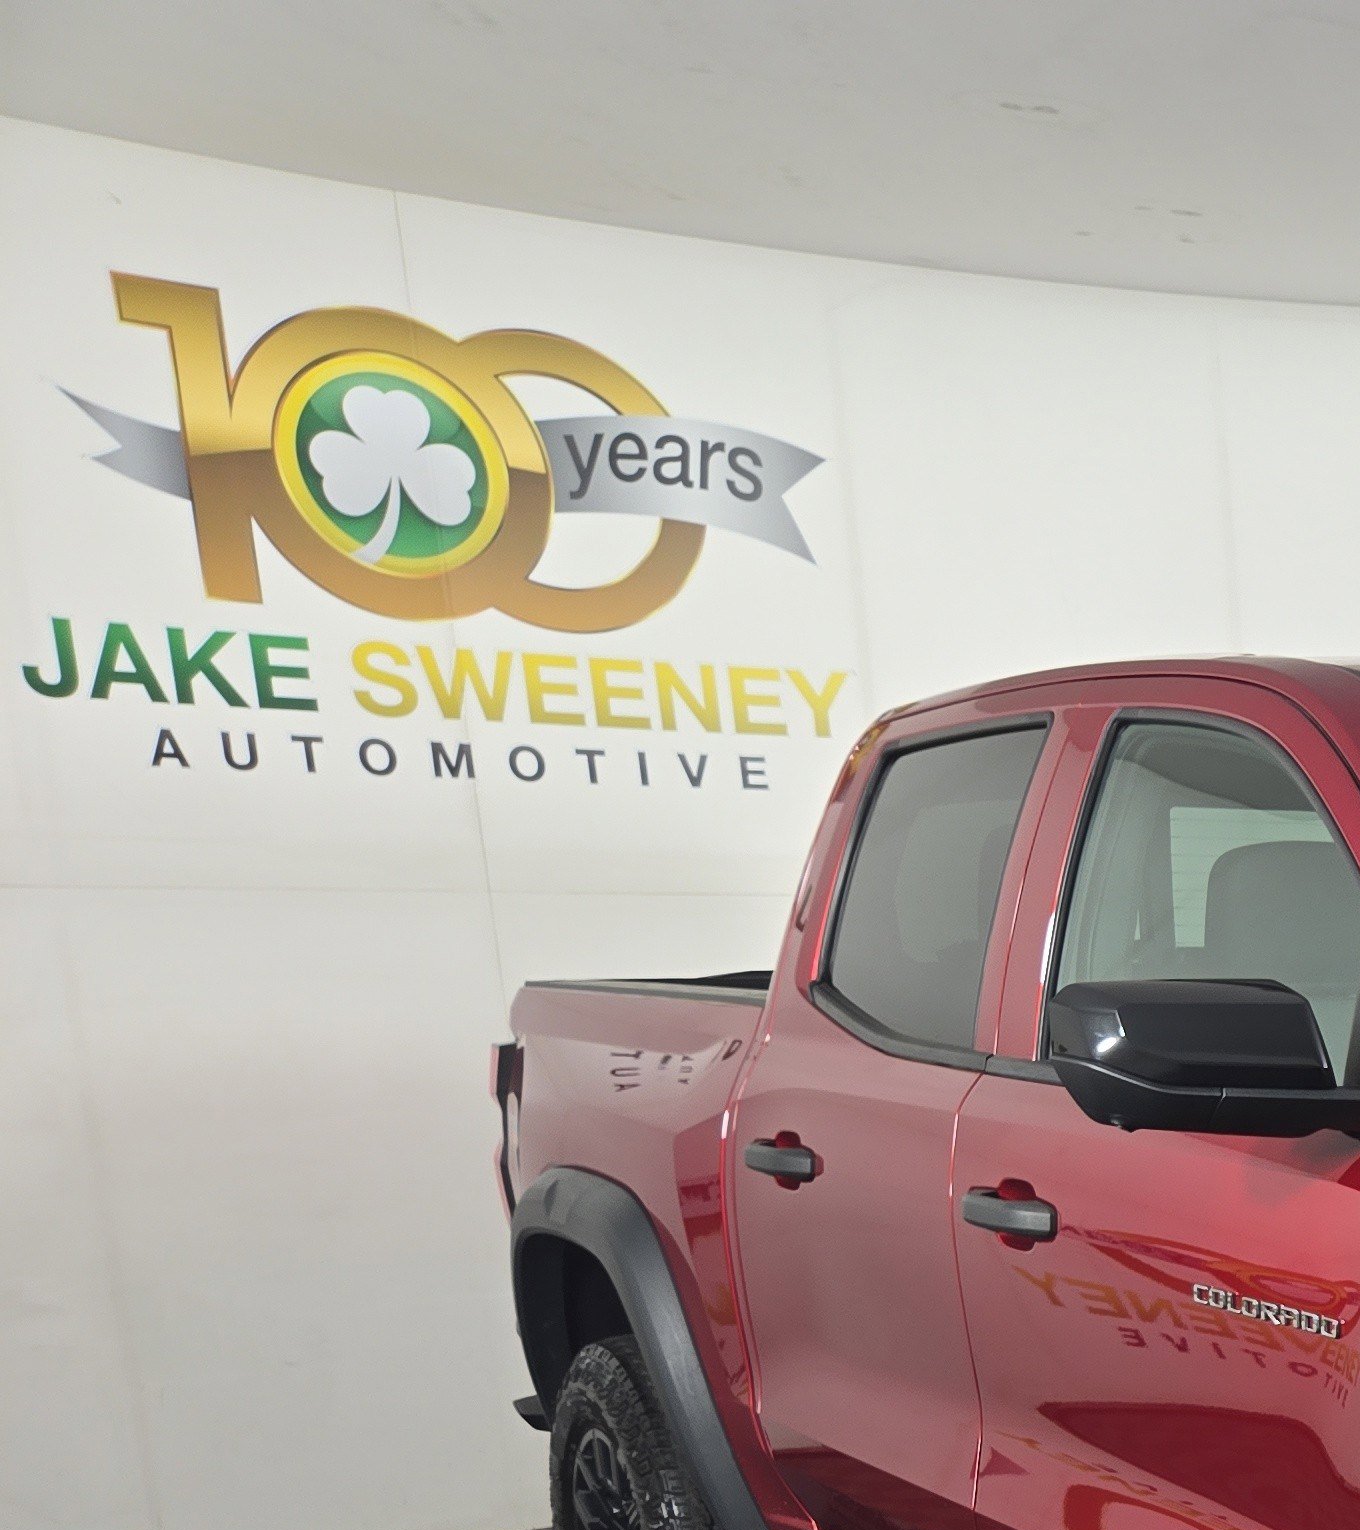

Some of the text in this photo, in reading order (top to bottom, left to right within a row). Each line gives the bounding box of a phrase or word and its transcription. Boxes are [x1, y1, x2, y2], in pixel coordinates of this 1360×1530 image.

[563, 430, 765, 504] years
[21, 616, 848, 738] JAKE SWEENEY
[151, 727, 770, 790] AUTOMOTIVE
[1193, 1283, 1342, 1339] COLORADO
